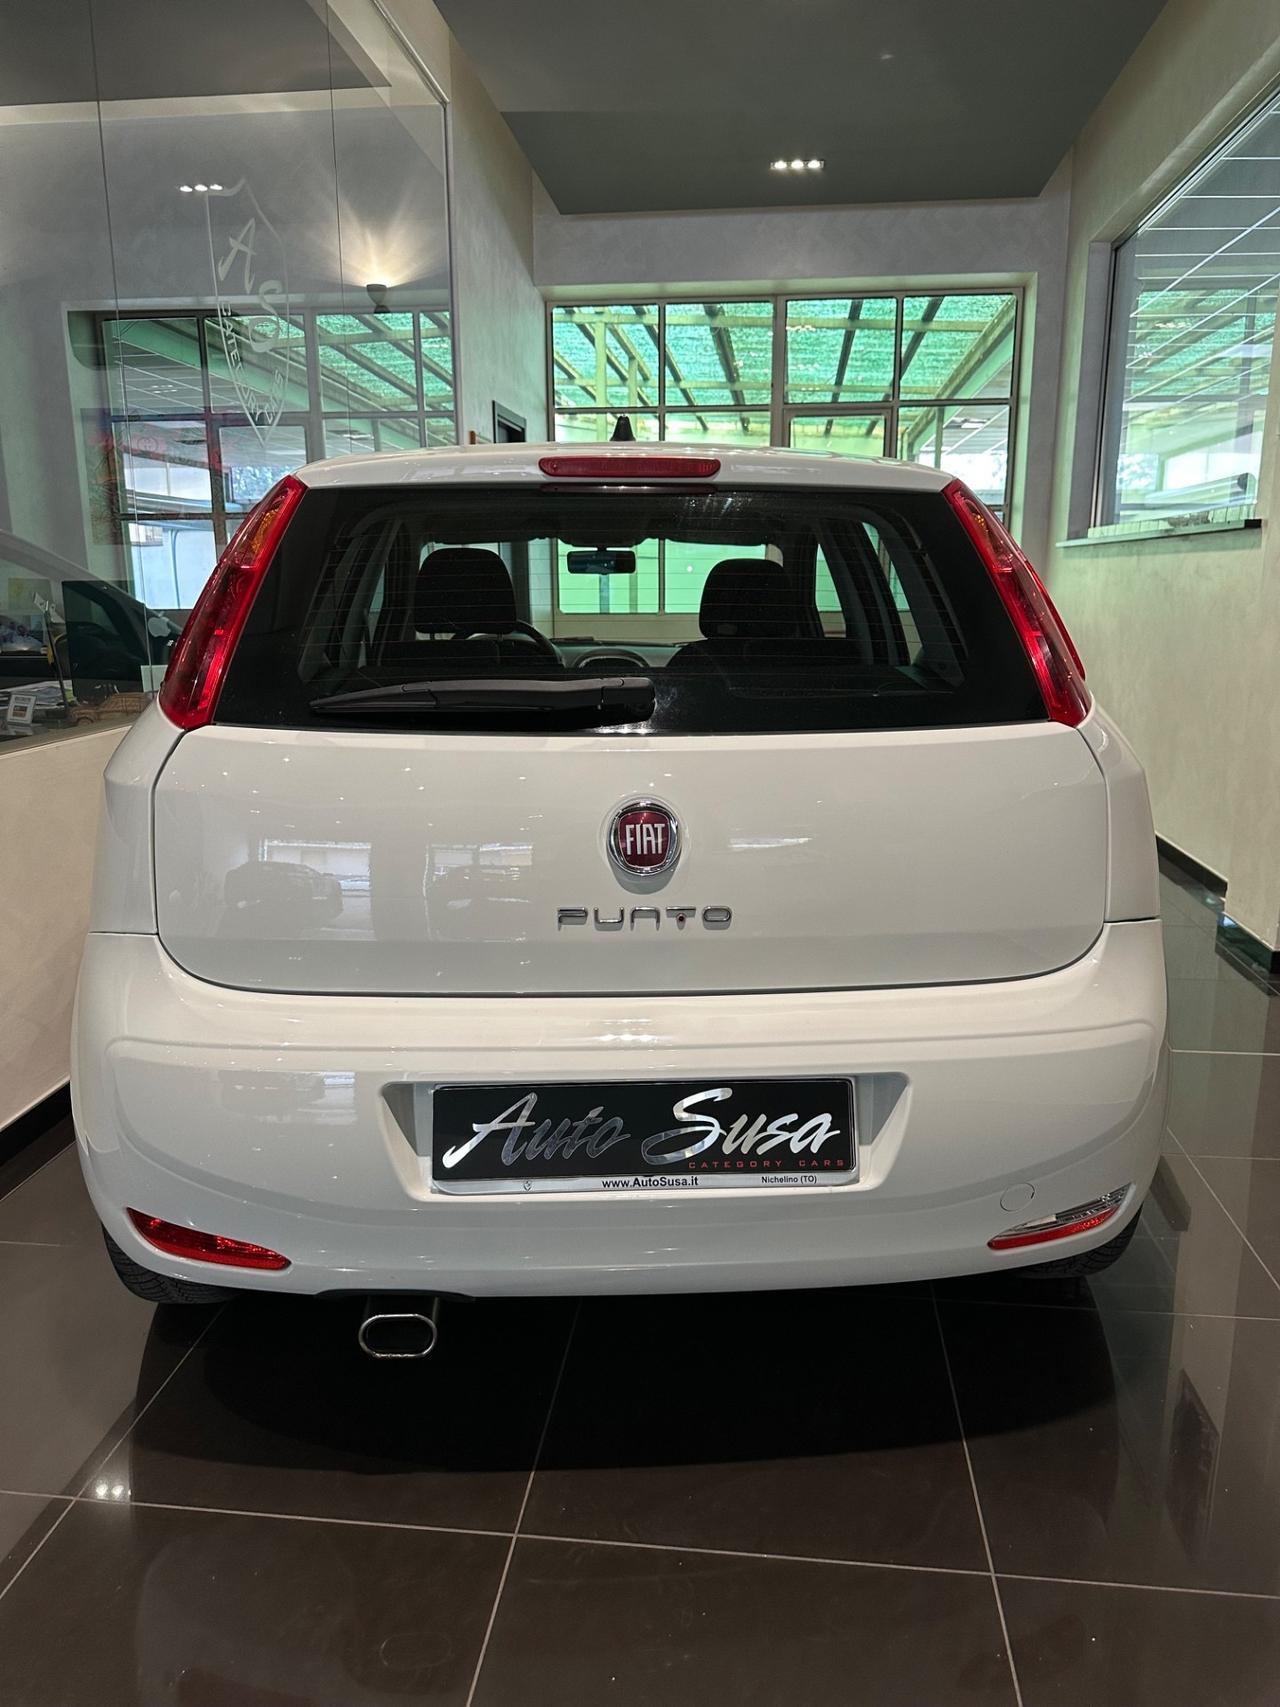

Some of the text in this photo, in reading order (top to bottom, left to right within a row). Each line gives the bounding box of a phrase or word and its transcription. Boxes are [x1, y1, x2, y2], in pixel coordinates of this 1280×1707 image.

[625, 823, 665, 855] FIAT
[557, 906, 732, 926] PUNTO
[442, 1087, 841, 1168] Auto Susa
[688, 1159, 845, 1169] CATEGORY CARS
[602, 1175, 699, 1188] www.AutoSusa.it
[761, 1175, 818, 1184] Nichelino (TO)
